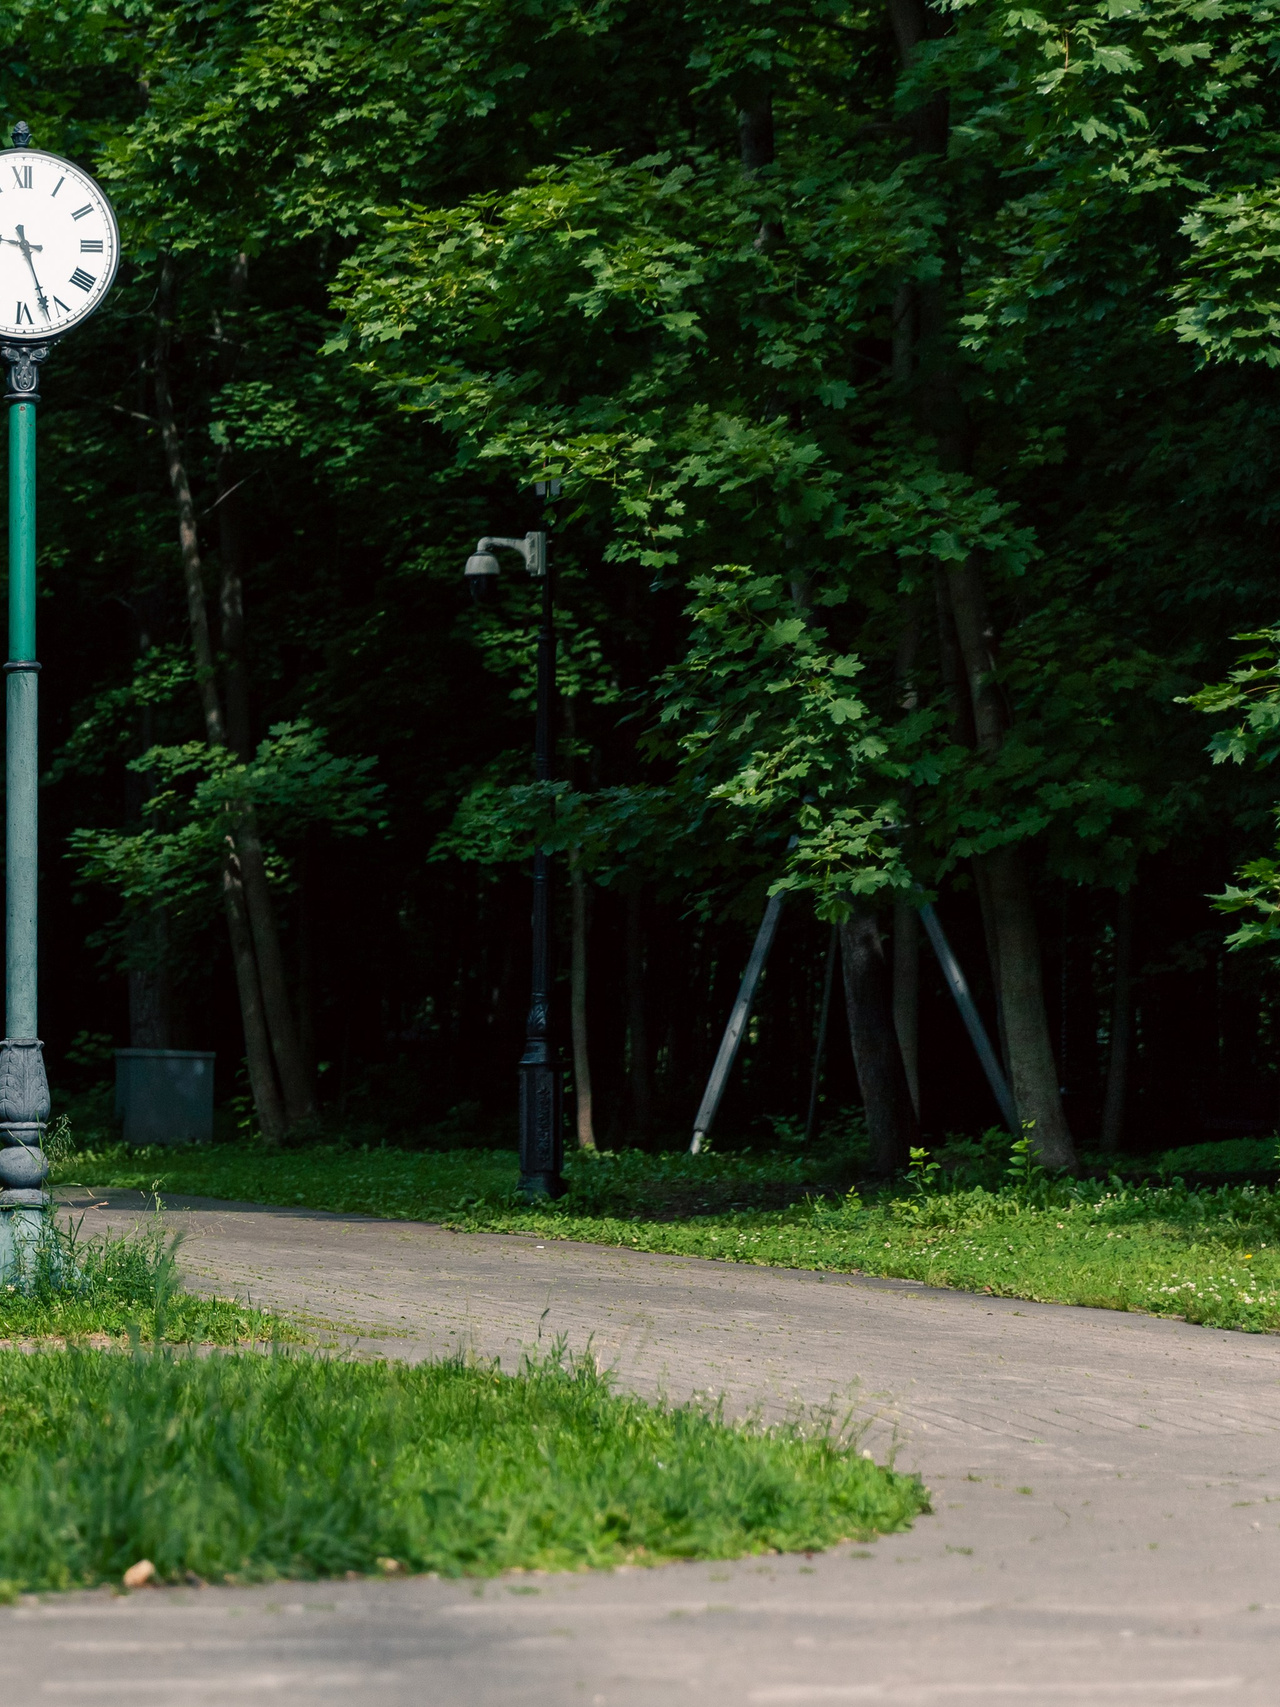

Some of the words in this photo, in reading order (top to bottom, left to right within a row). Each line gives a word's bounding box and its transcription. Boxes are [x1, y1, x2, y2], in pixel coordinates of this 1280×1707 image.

[11, 165, 33, 189] XII
[51, 176, 66, 198] I
[70, 202, 95, 222] II
[80, 239, 103, 254] III
[68, 266, 98, 294] IIII
[15, 301, 35, 325] VI
[53, 295, 72, 319] V
